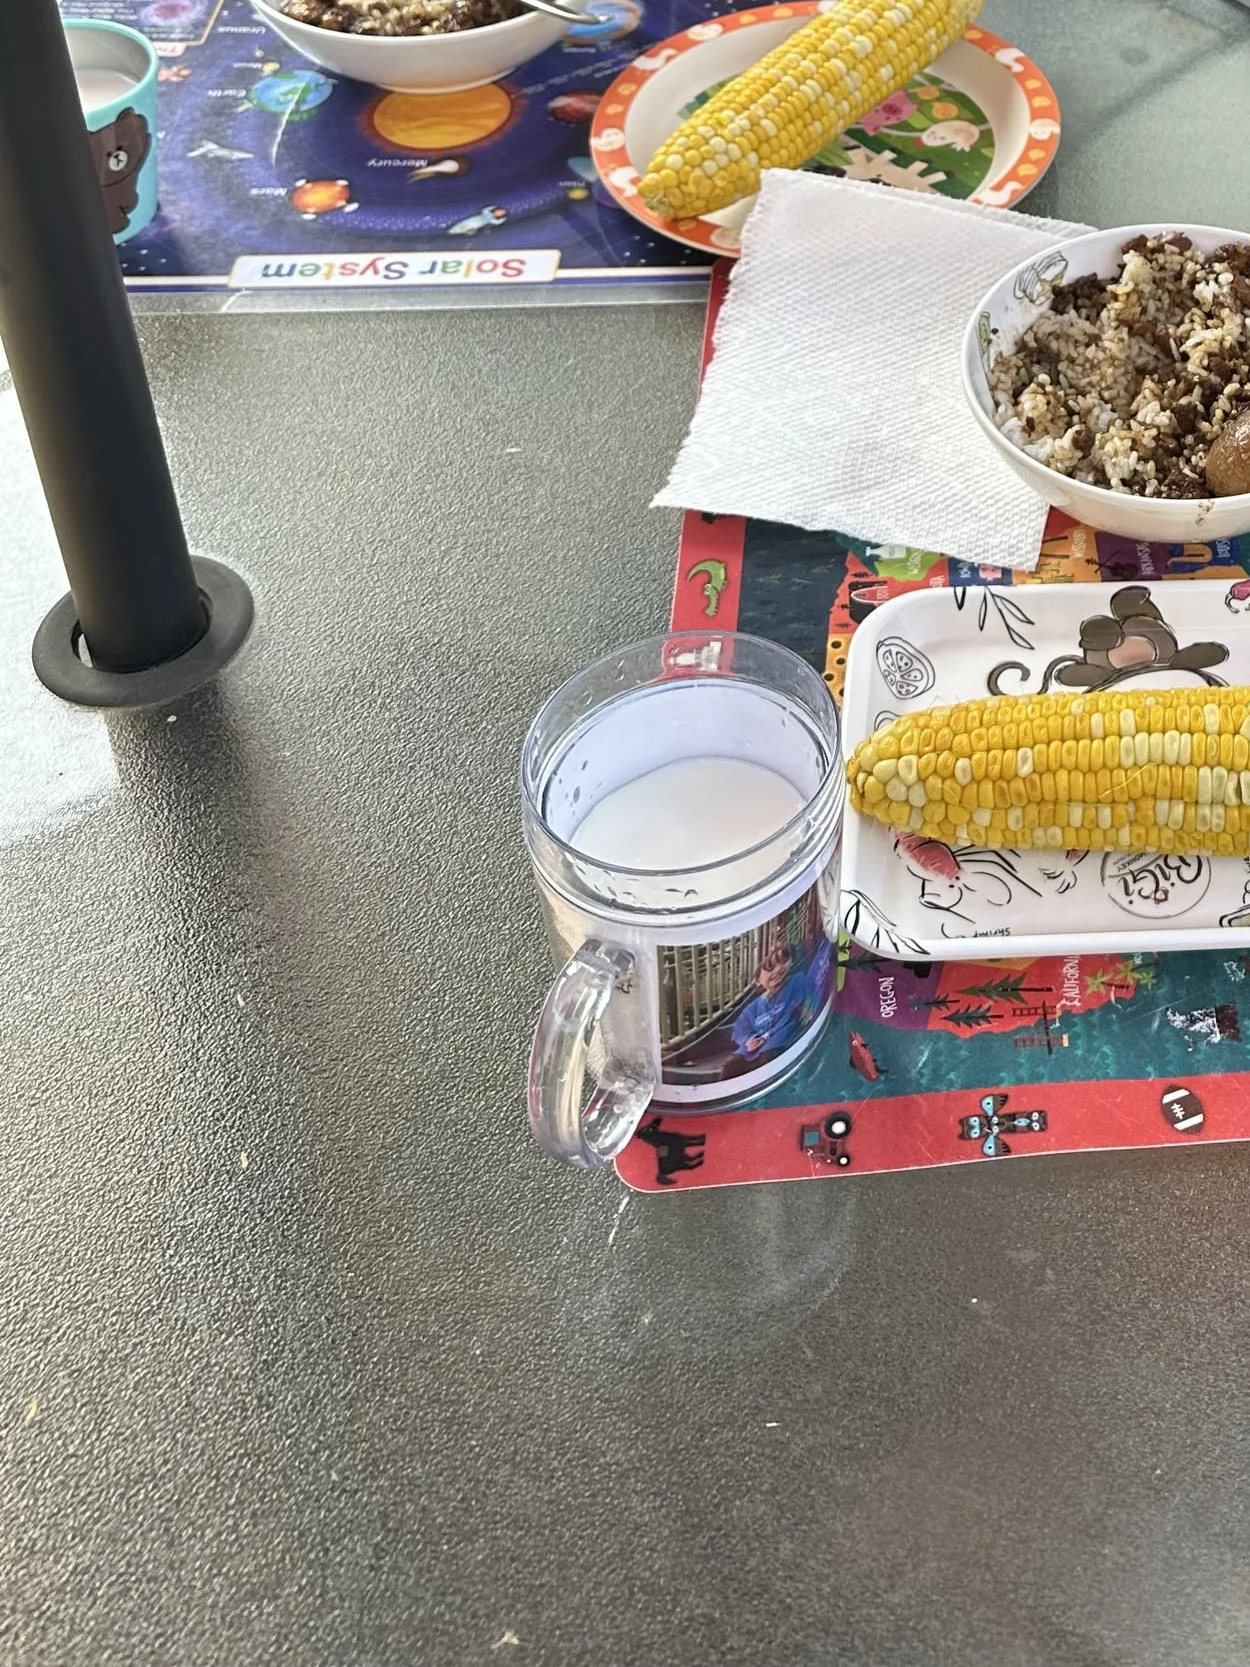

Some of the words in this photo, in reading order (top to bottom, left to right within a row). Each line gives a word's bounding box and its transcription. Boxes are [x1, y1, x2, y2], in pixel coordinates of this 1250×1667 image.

[207, 88, 247, 98] Earth
[367, 157, 428, 168] Mercury
[250, 187, 288, 197] Mars
[261, 256, 409, 281] System
[420, 258, 527, 278] Solar
[878, 976, 896, 1018] OREGON
